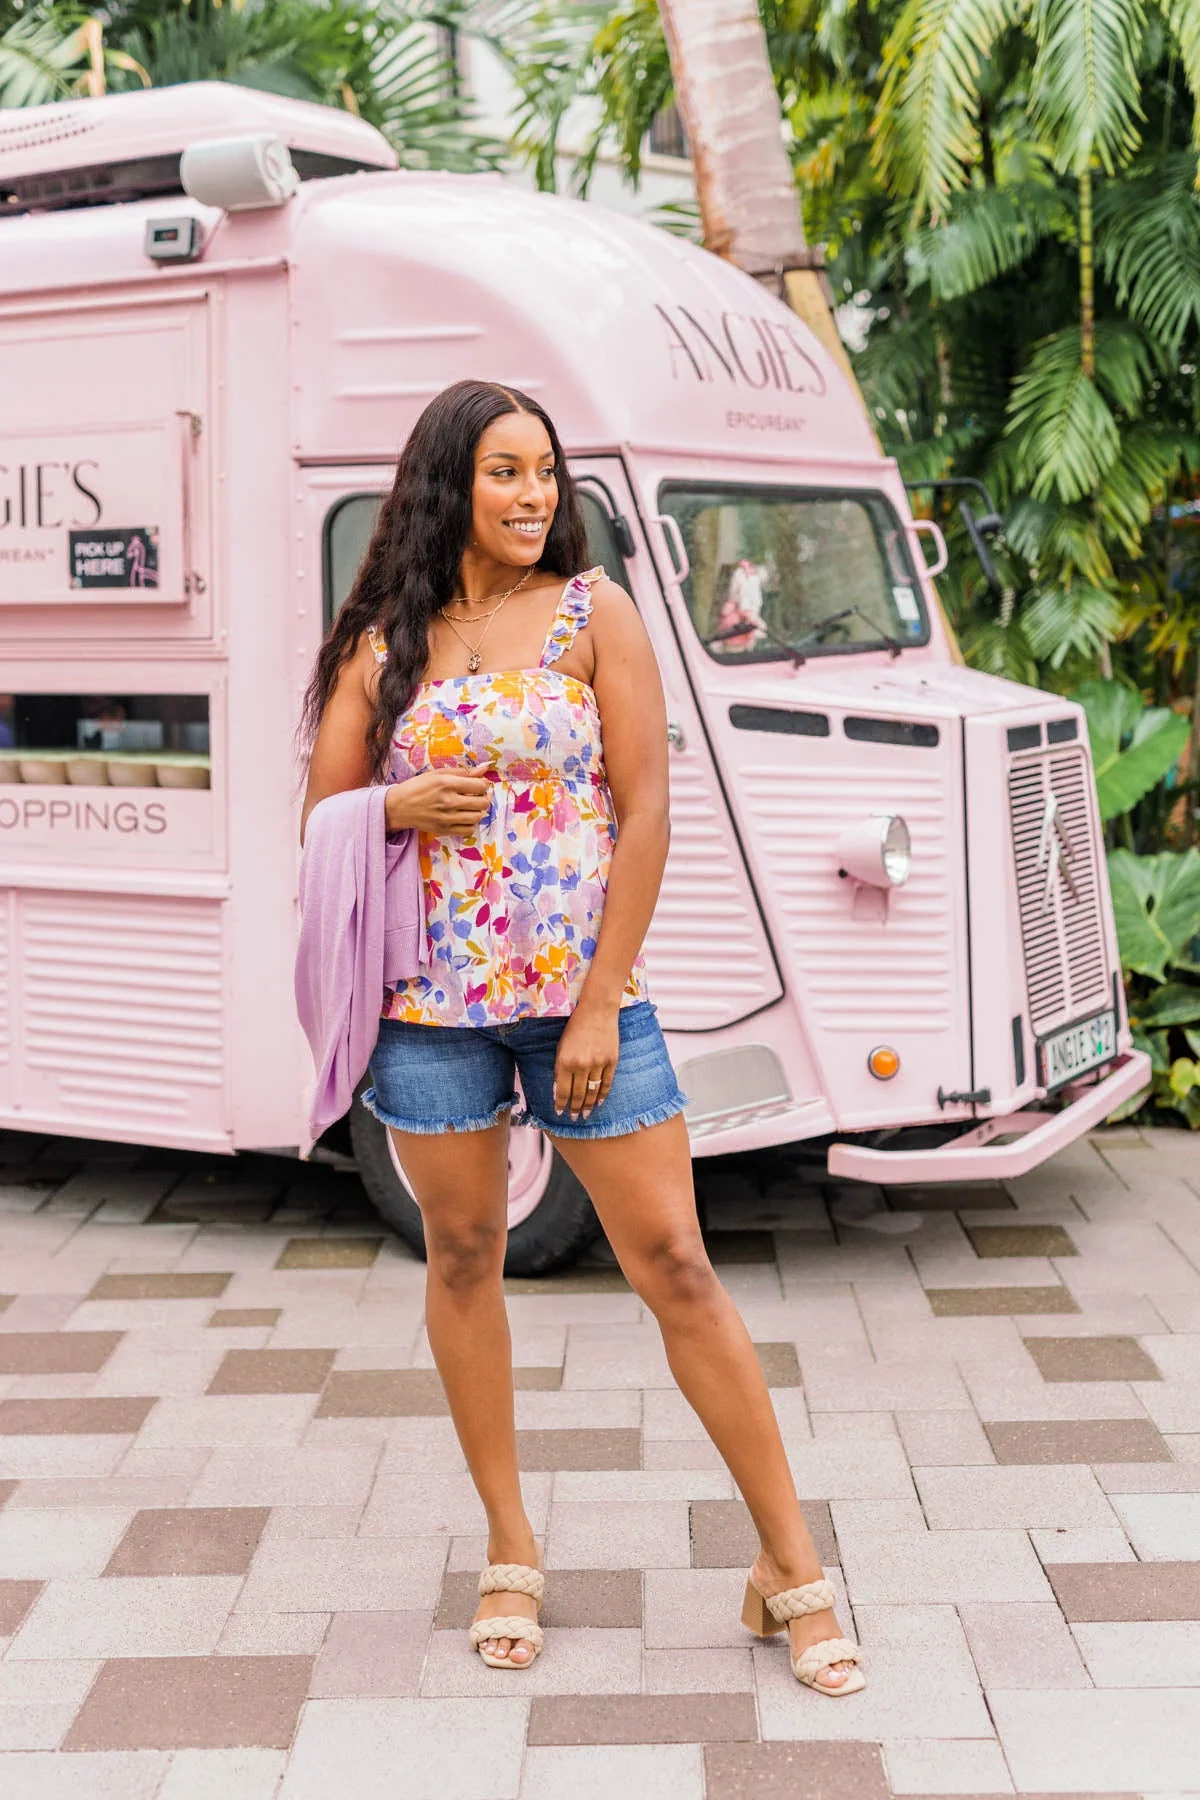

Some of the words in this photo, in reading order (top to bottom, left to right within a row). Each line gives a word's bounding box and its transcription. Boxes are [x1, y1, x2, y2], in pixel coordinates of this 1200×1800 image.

[74, 542, 104, 558] PICK
[106, 541, 125, 556] UP
[74, 558, 126, 576] HERE
[0, 798, 168, 834] OPPINGS
